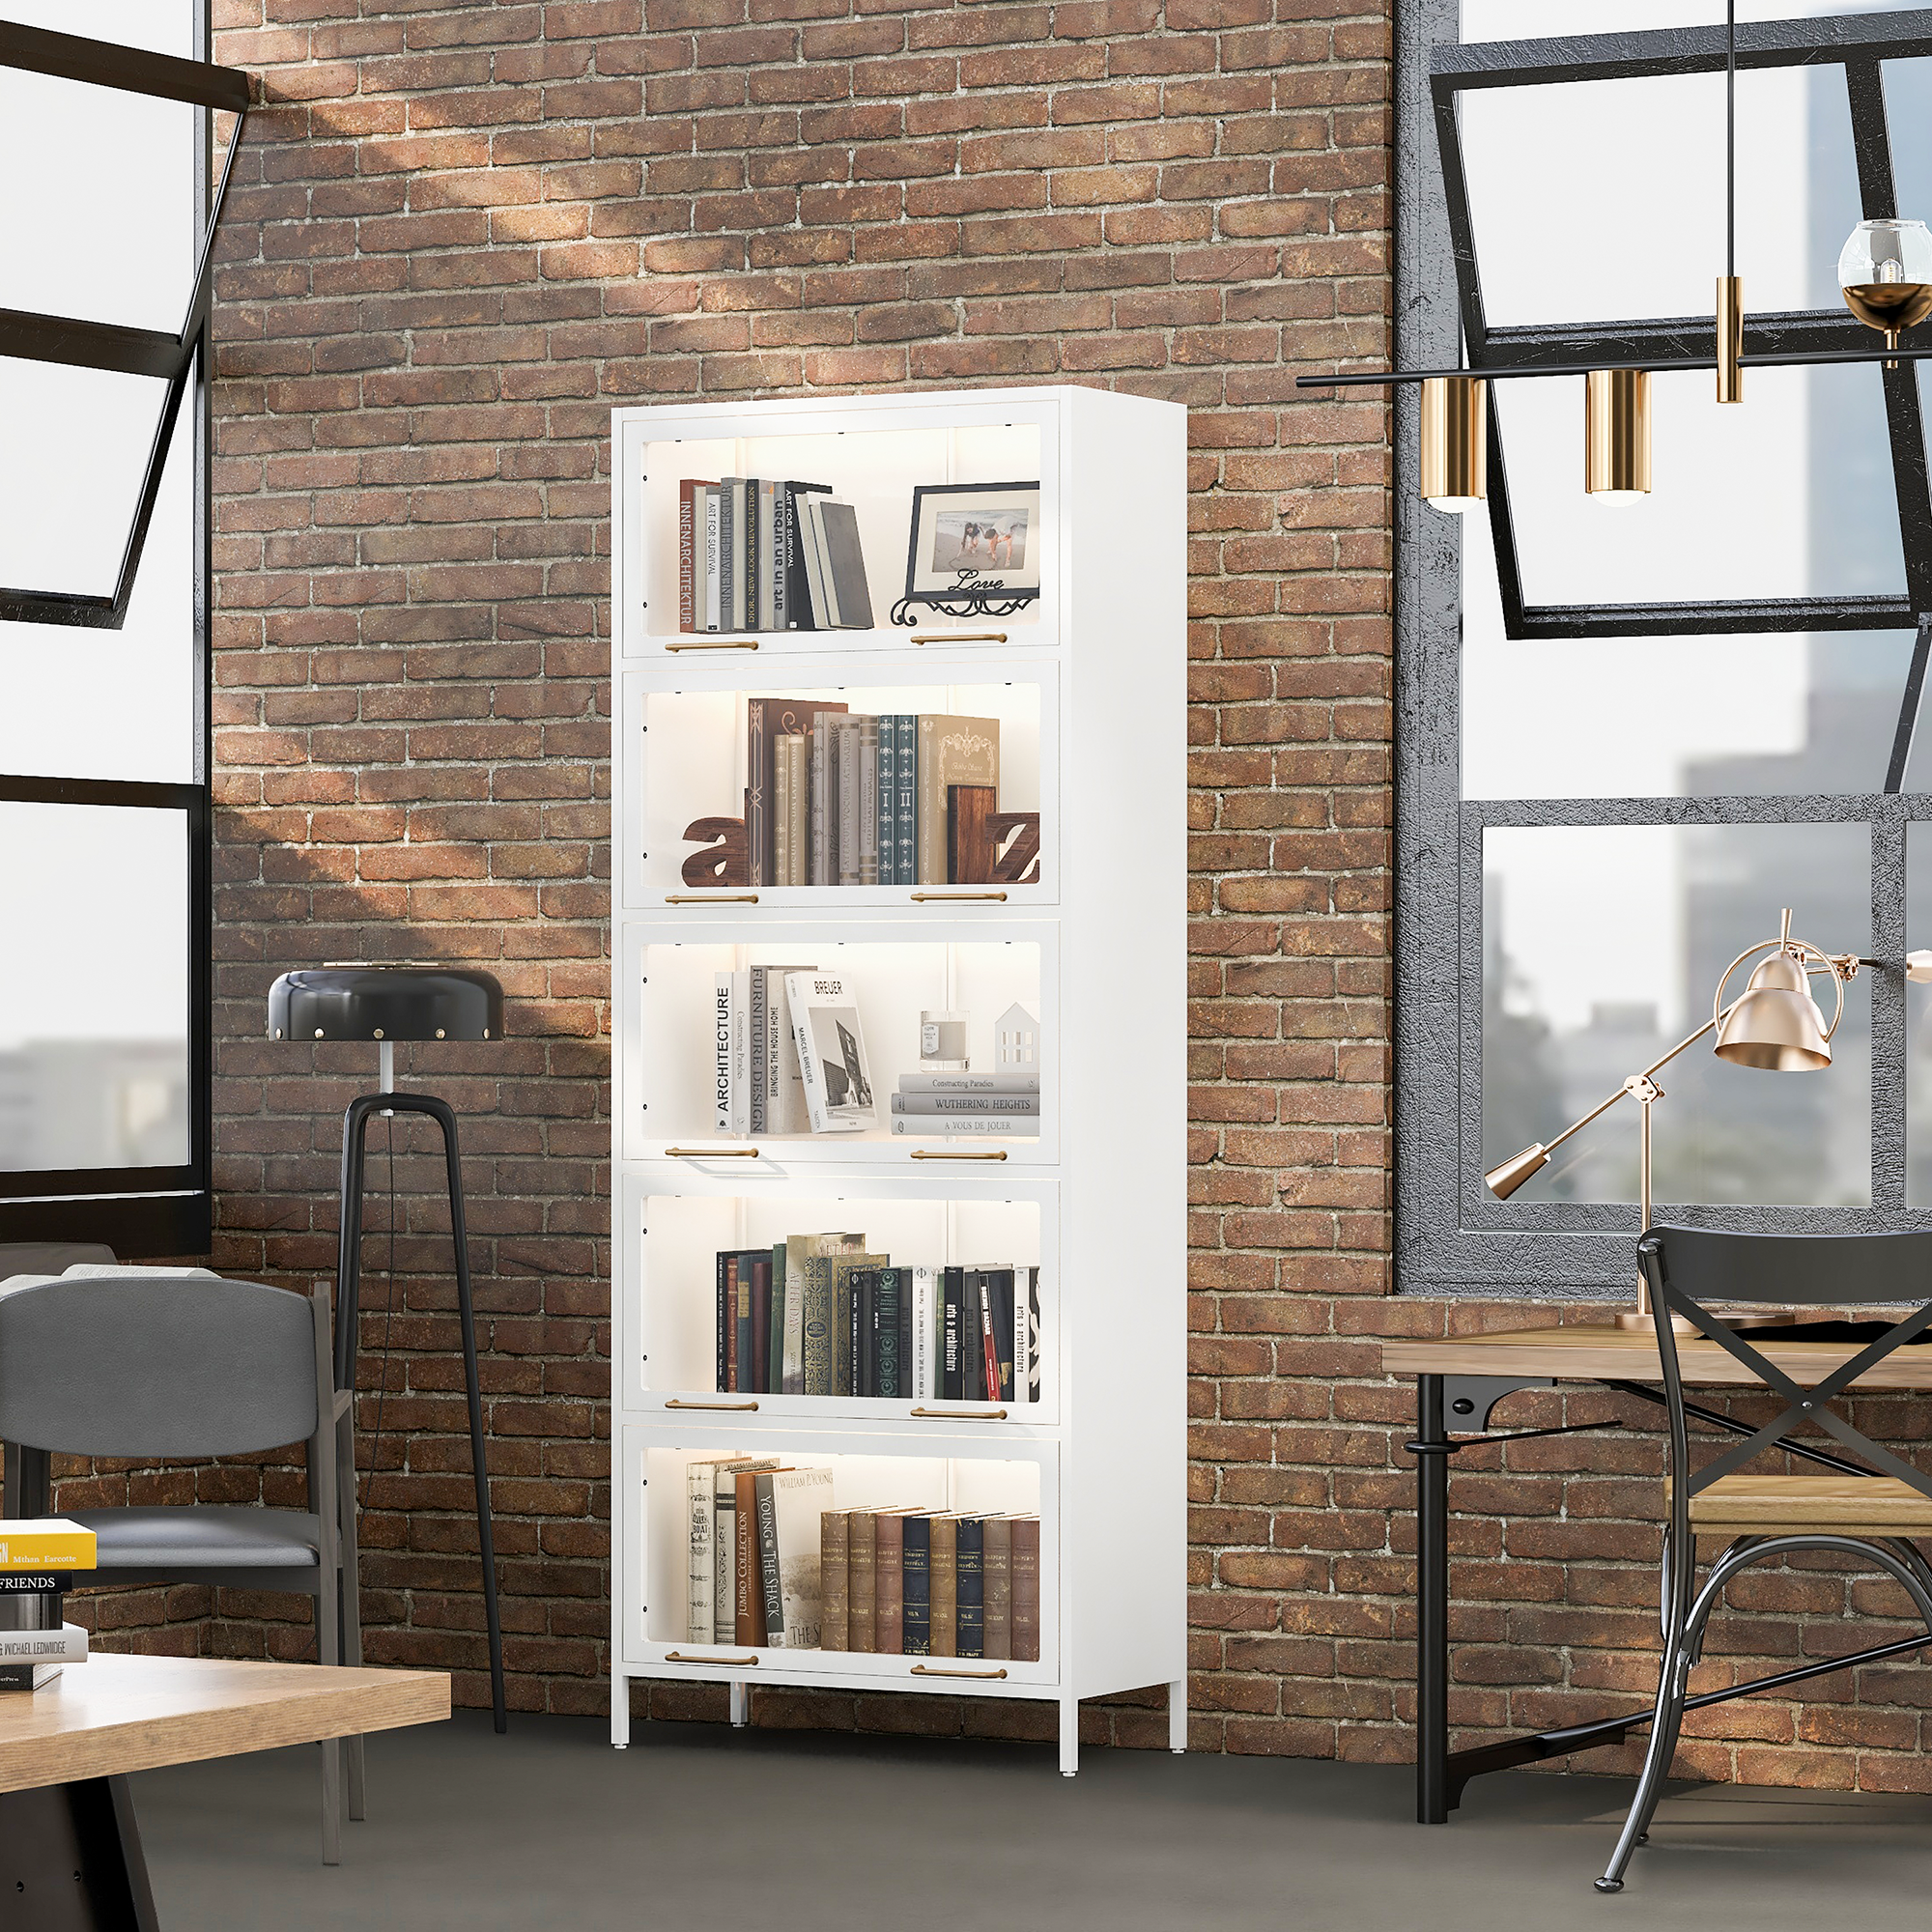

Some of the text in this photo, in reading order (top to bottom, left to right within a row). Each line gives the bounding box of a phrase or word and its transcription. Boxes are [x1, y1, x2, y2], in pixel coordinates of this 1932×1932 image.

[680, 500, 692, 624] INNENARCHITEKTUR
[774, 500, 783, 611] art in an urban
[948, 568, 1005, 591] Love
[813, 980, 843, 995] BREUER
[717, 987, 729, 1112] ARCHITECTURE
[753, 968, 763, 1133] FURNITURE DESIGN
[770, 1007, 779, 1097] BRINGING THE HOUSE HOME
[798, 1027, 813, 1085] MARCEL BREUER
[932, 1079, 968, 1089] Constructing
[935, 1098, 1031, 1110] WUTHERING HEIGHTS
[952, 1122, 973, 1130] VOUS
[975, 1122, 985, 1130] DE
[987, 1122, 1011, 1131] JOUER
[788, 1308, 800, 1335] DAYS
[946, 1304, 958, 1319] arts
[946, 1329, 958, 1372] architecture
[779, 1477, 805, 1489] WILLIAM
[811, 1472, 834, 1485] YOUNG
[738, 1511, 750, 1617] JUMBO COLLECTION
[759, 1494, 780, 1618] YOUNG THE SHACK
[0, 1577, 56, 1589] FRIENDS
[790, 1625, 810, 1645] THE
[5, 1642, 32, 1656] MICHAEL
